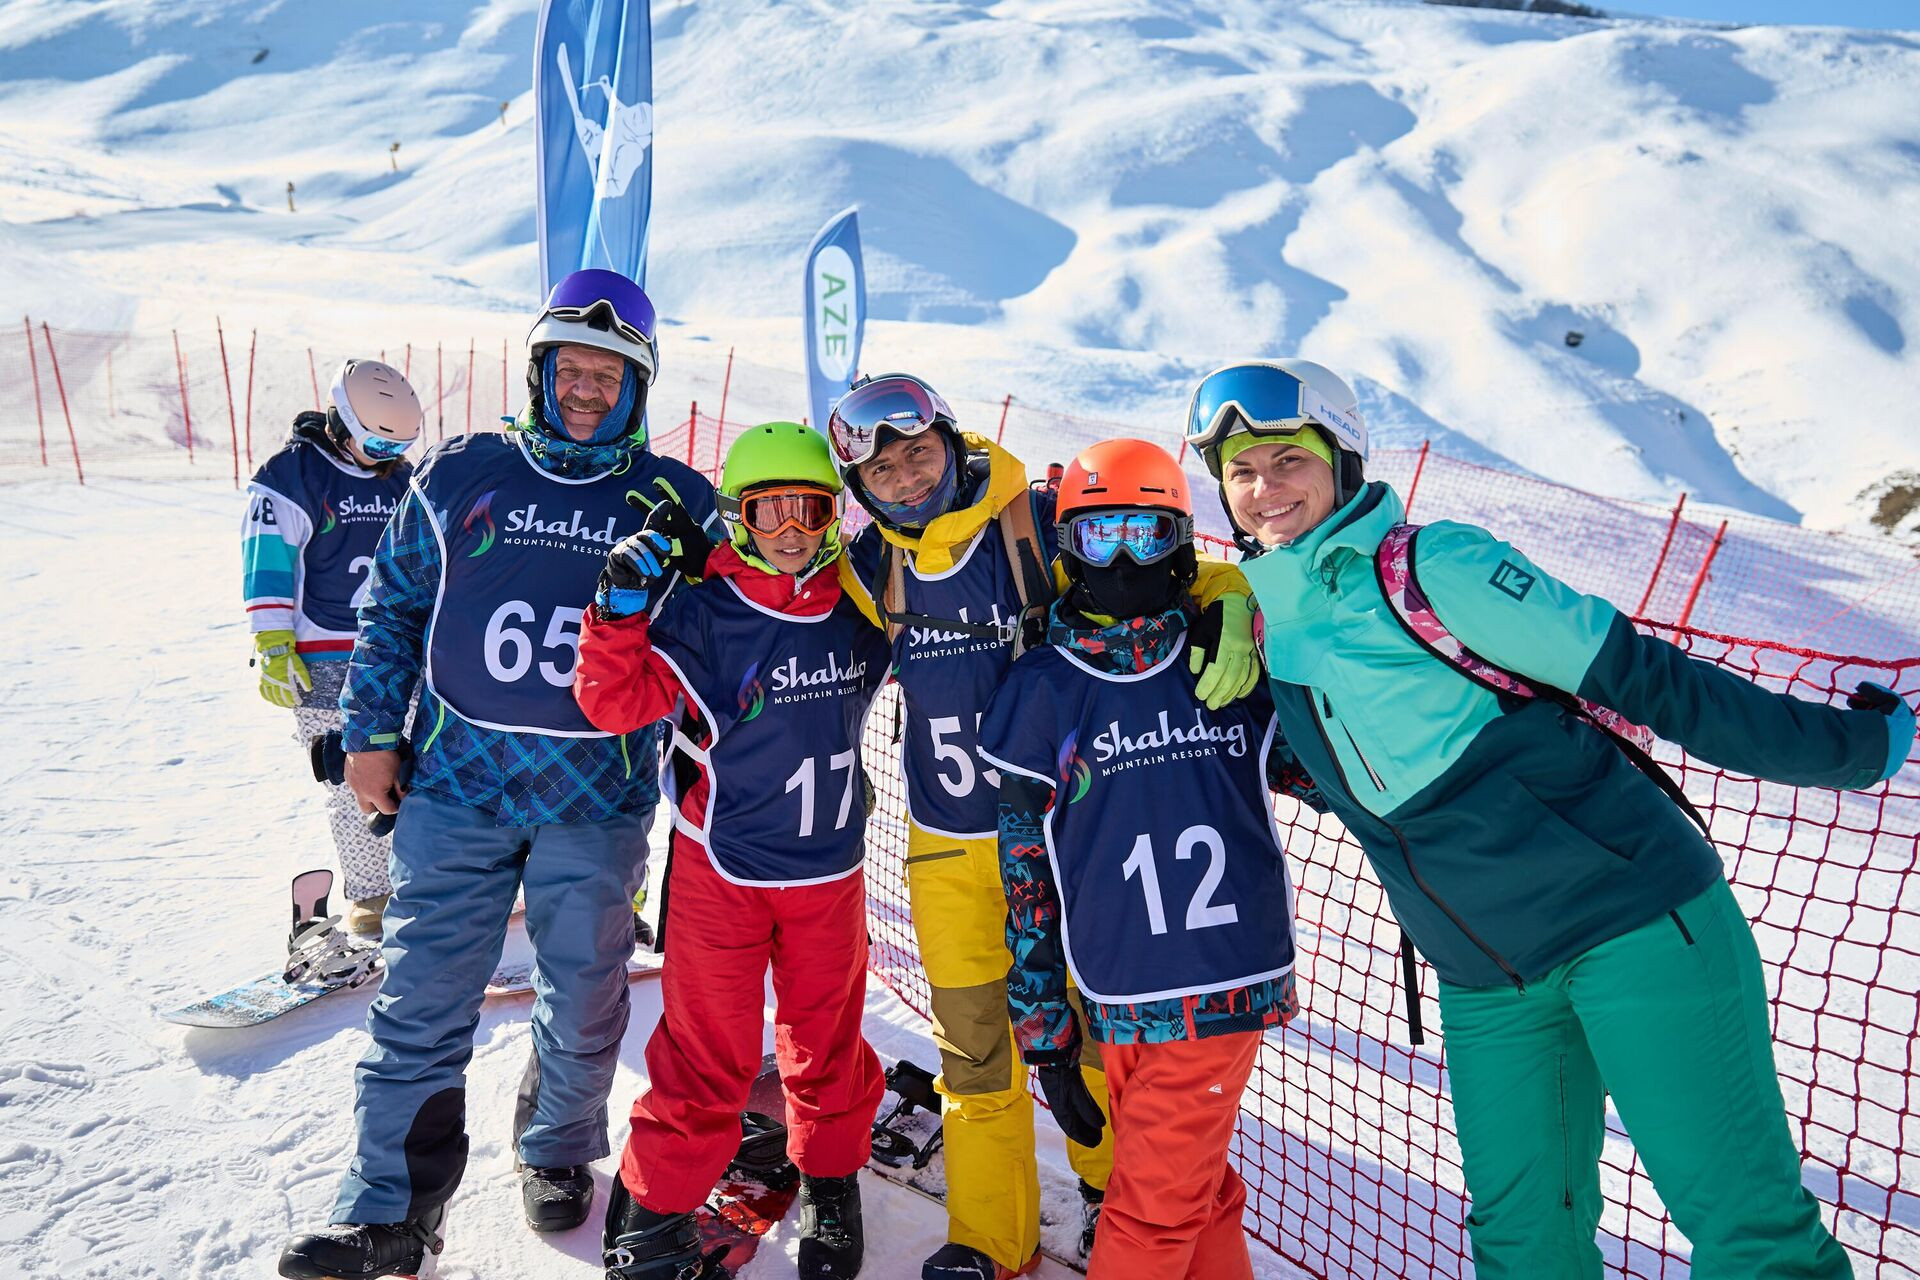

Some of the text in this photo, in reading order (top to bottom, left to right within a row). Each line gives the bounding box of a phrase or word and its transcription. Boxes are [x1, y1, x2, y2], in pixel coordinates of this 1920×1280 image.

[821, 272, 848, 357] AZE
[1320, 404, 1361, 441] HEAD
[503, 537, 566, 549] MOUNTAIN
[484, 600, 585, 688] 65
[909, 646, 965, 661] MOUNTAIN
[774, 689, 833, 705] MOUNTAIN
[1092, 708, 1248, 763] Shahdag
[1102, 746, 1218, 777] MOUNTAIN RESORT
[784, 747, 856, 837] 17
[1121, 824, 1239, 936] 12
